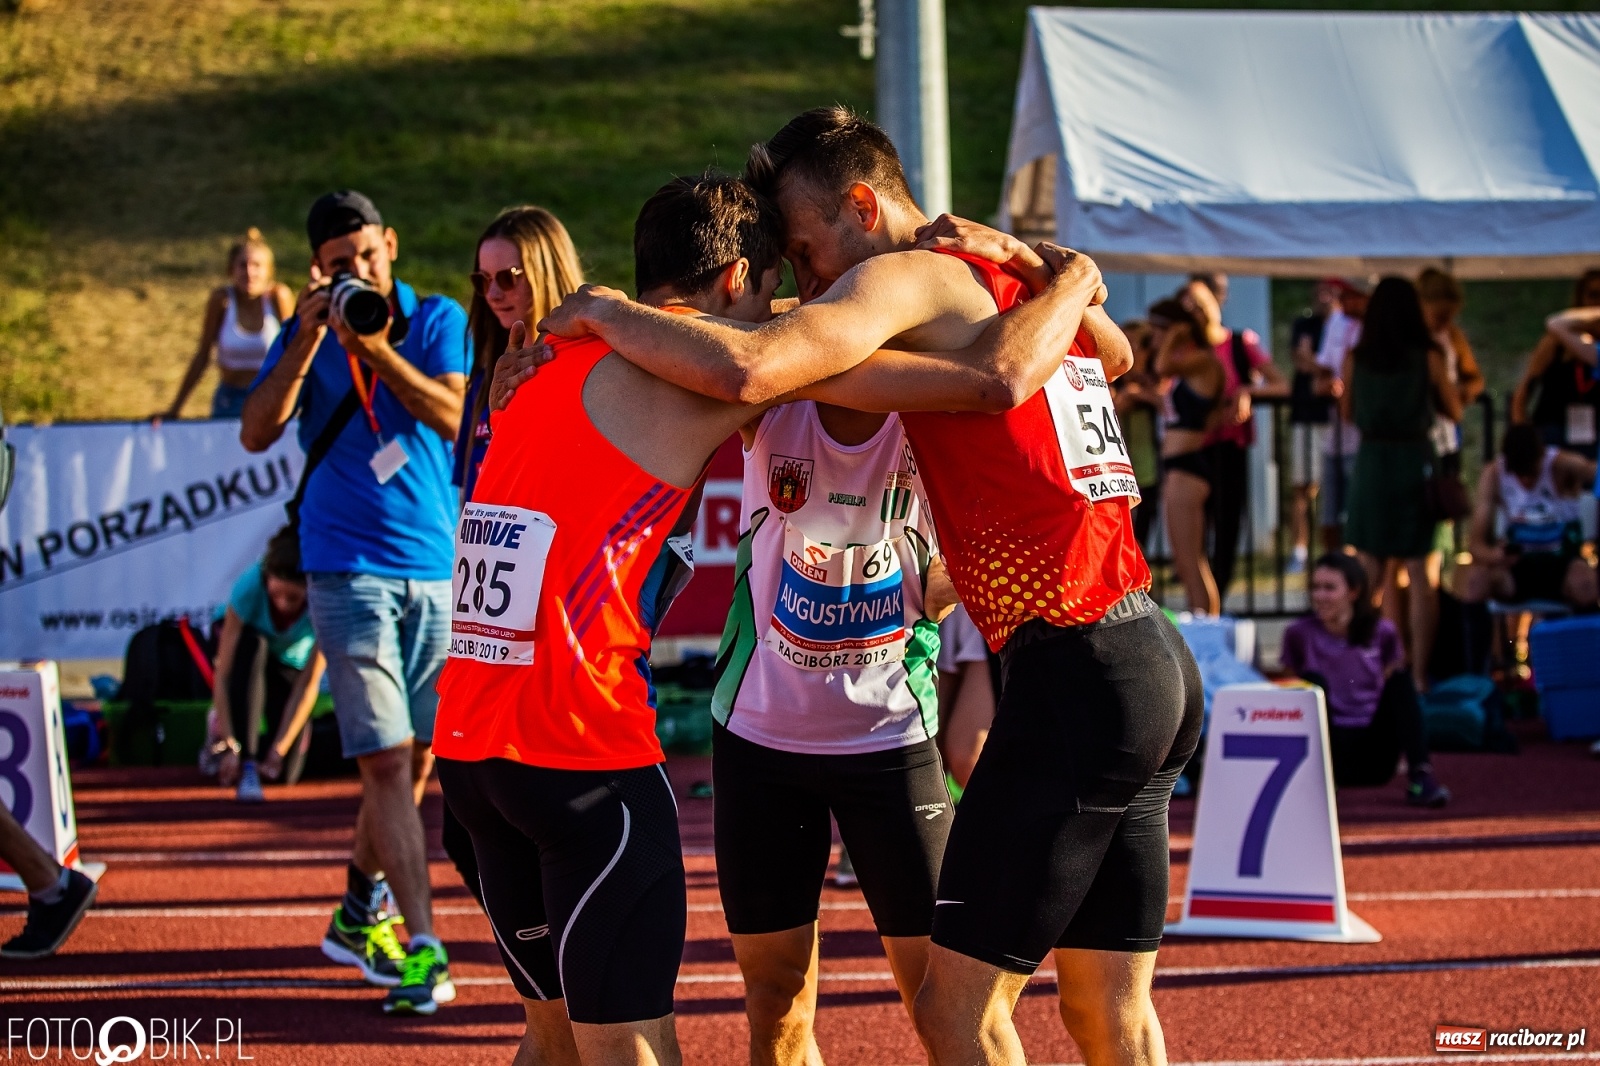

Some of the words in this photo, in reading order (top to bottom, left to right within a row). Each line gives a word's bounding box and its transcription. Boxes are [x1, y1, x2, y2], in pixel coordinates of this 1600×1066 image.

[1076, 404, 1127, 456] 54
[37, 455, 296, 570] PORZĄDKU!
[499, 510, 518, 521] Move
[791, 553, 826, 581] ORLEN
[862, 542, 892, 579] 69
[456, 556, 516, 618] 285
[780, 583, 901, 627] AUGUSTYNIAK
[479, 642, 510, 661] 2019
[778, 640, 850, 668] RACIBÓRZ
[853, 648, 888, 666] 2019
[1222, 733, 1309, 878] 7
